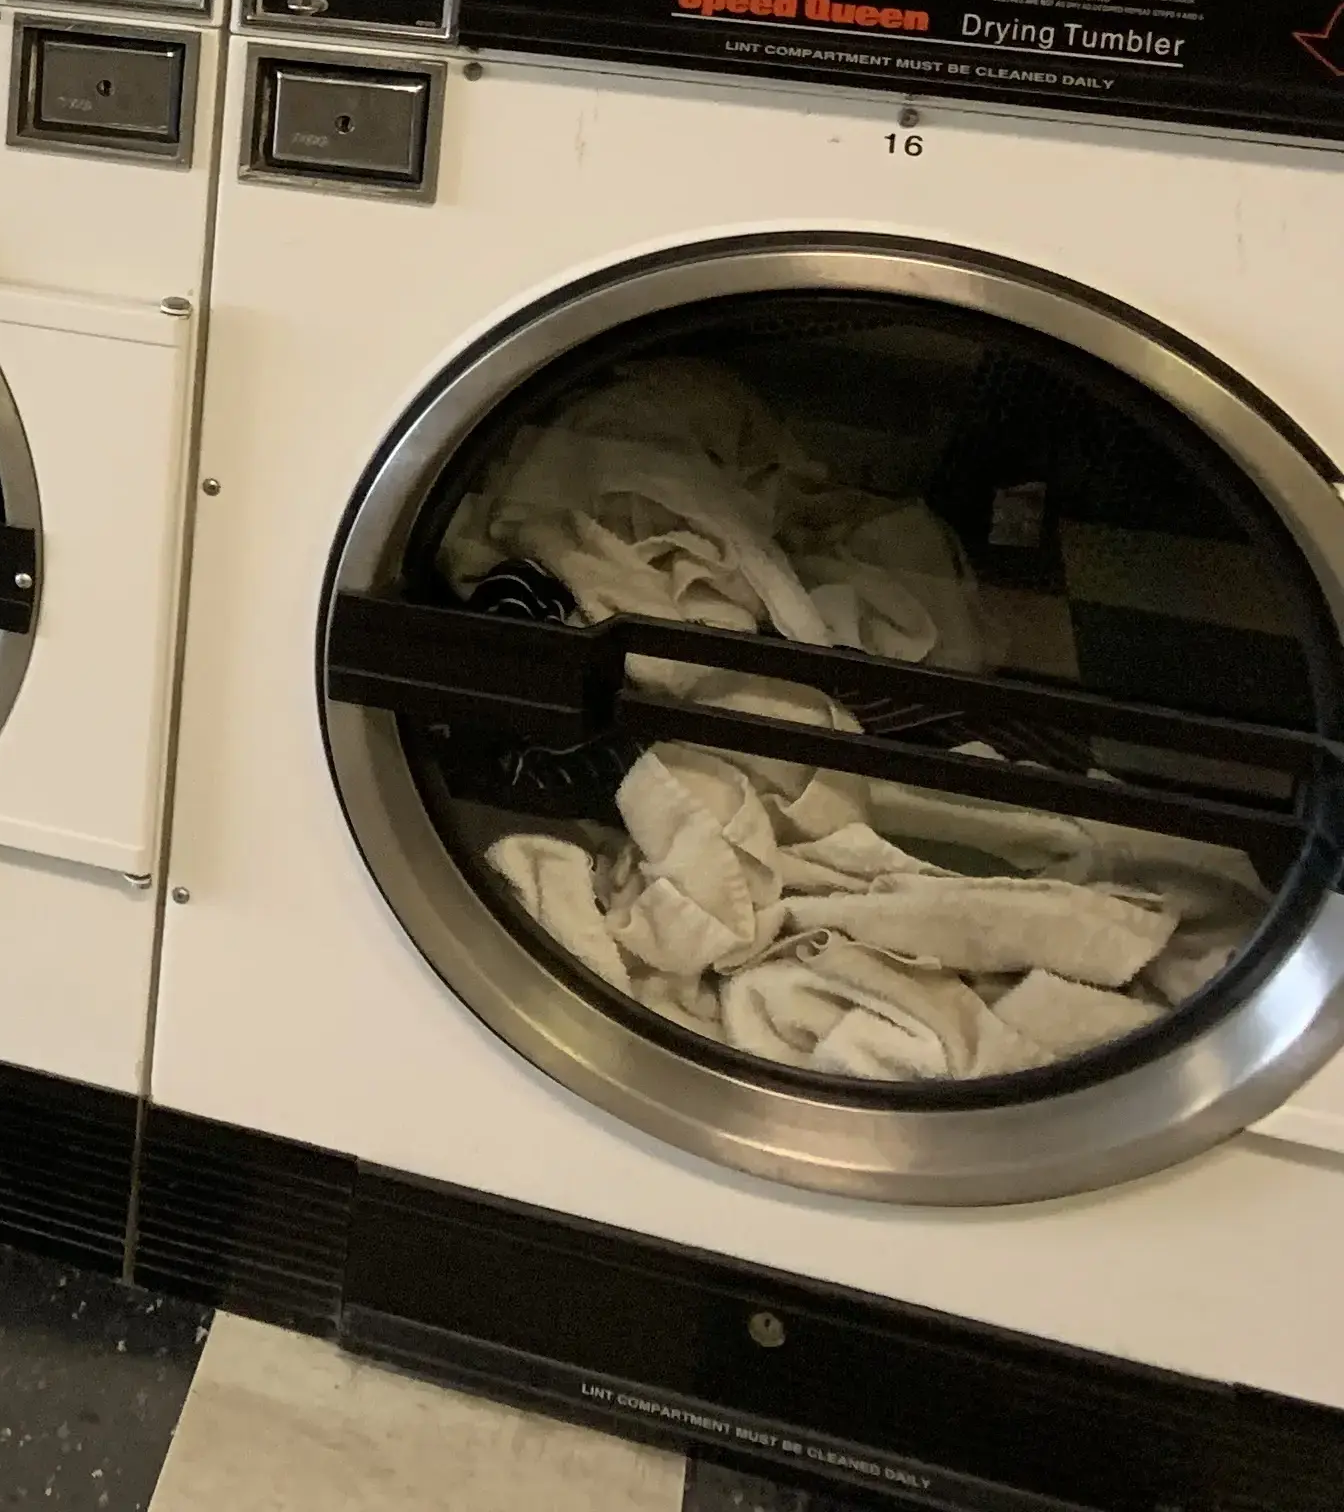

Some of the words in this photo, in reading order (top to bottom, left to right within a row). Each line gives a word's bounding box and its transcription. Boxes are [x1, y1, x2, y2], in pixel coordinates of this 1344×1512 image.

[962, 13, 1055, 50] Drying
[1064, 23, 1185, 57] Tumbler
[725, 40, 761, 54] LINT
[764, 44, 891, 68] COMPARTMENT
[896, 57, 941, 74] MUST
[947, 63, 971, 76] BE
[975, 66, 1058, 85] CLEANED
[1062, 74, 1114, 90] DAILY
[884, 133, 923, 157] 16
[581, 1383, 613, 1404] LINT
[617, 1394, 730, 1435] COMPARTMENT
[736, 1426, 777, 1447] MUST
[782, 1440, 802, 1455] BE
[806, 1447, 881, 1477] CLEANED
[885, 1467, 931, 1489] DAILY
